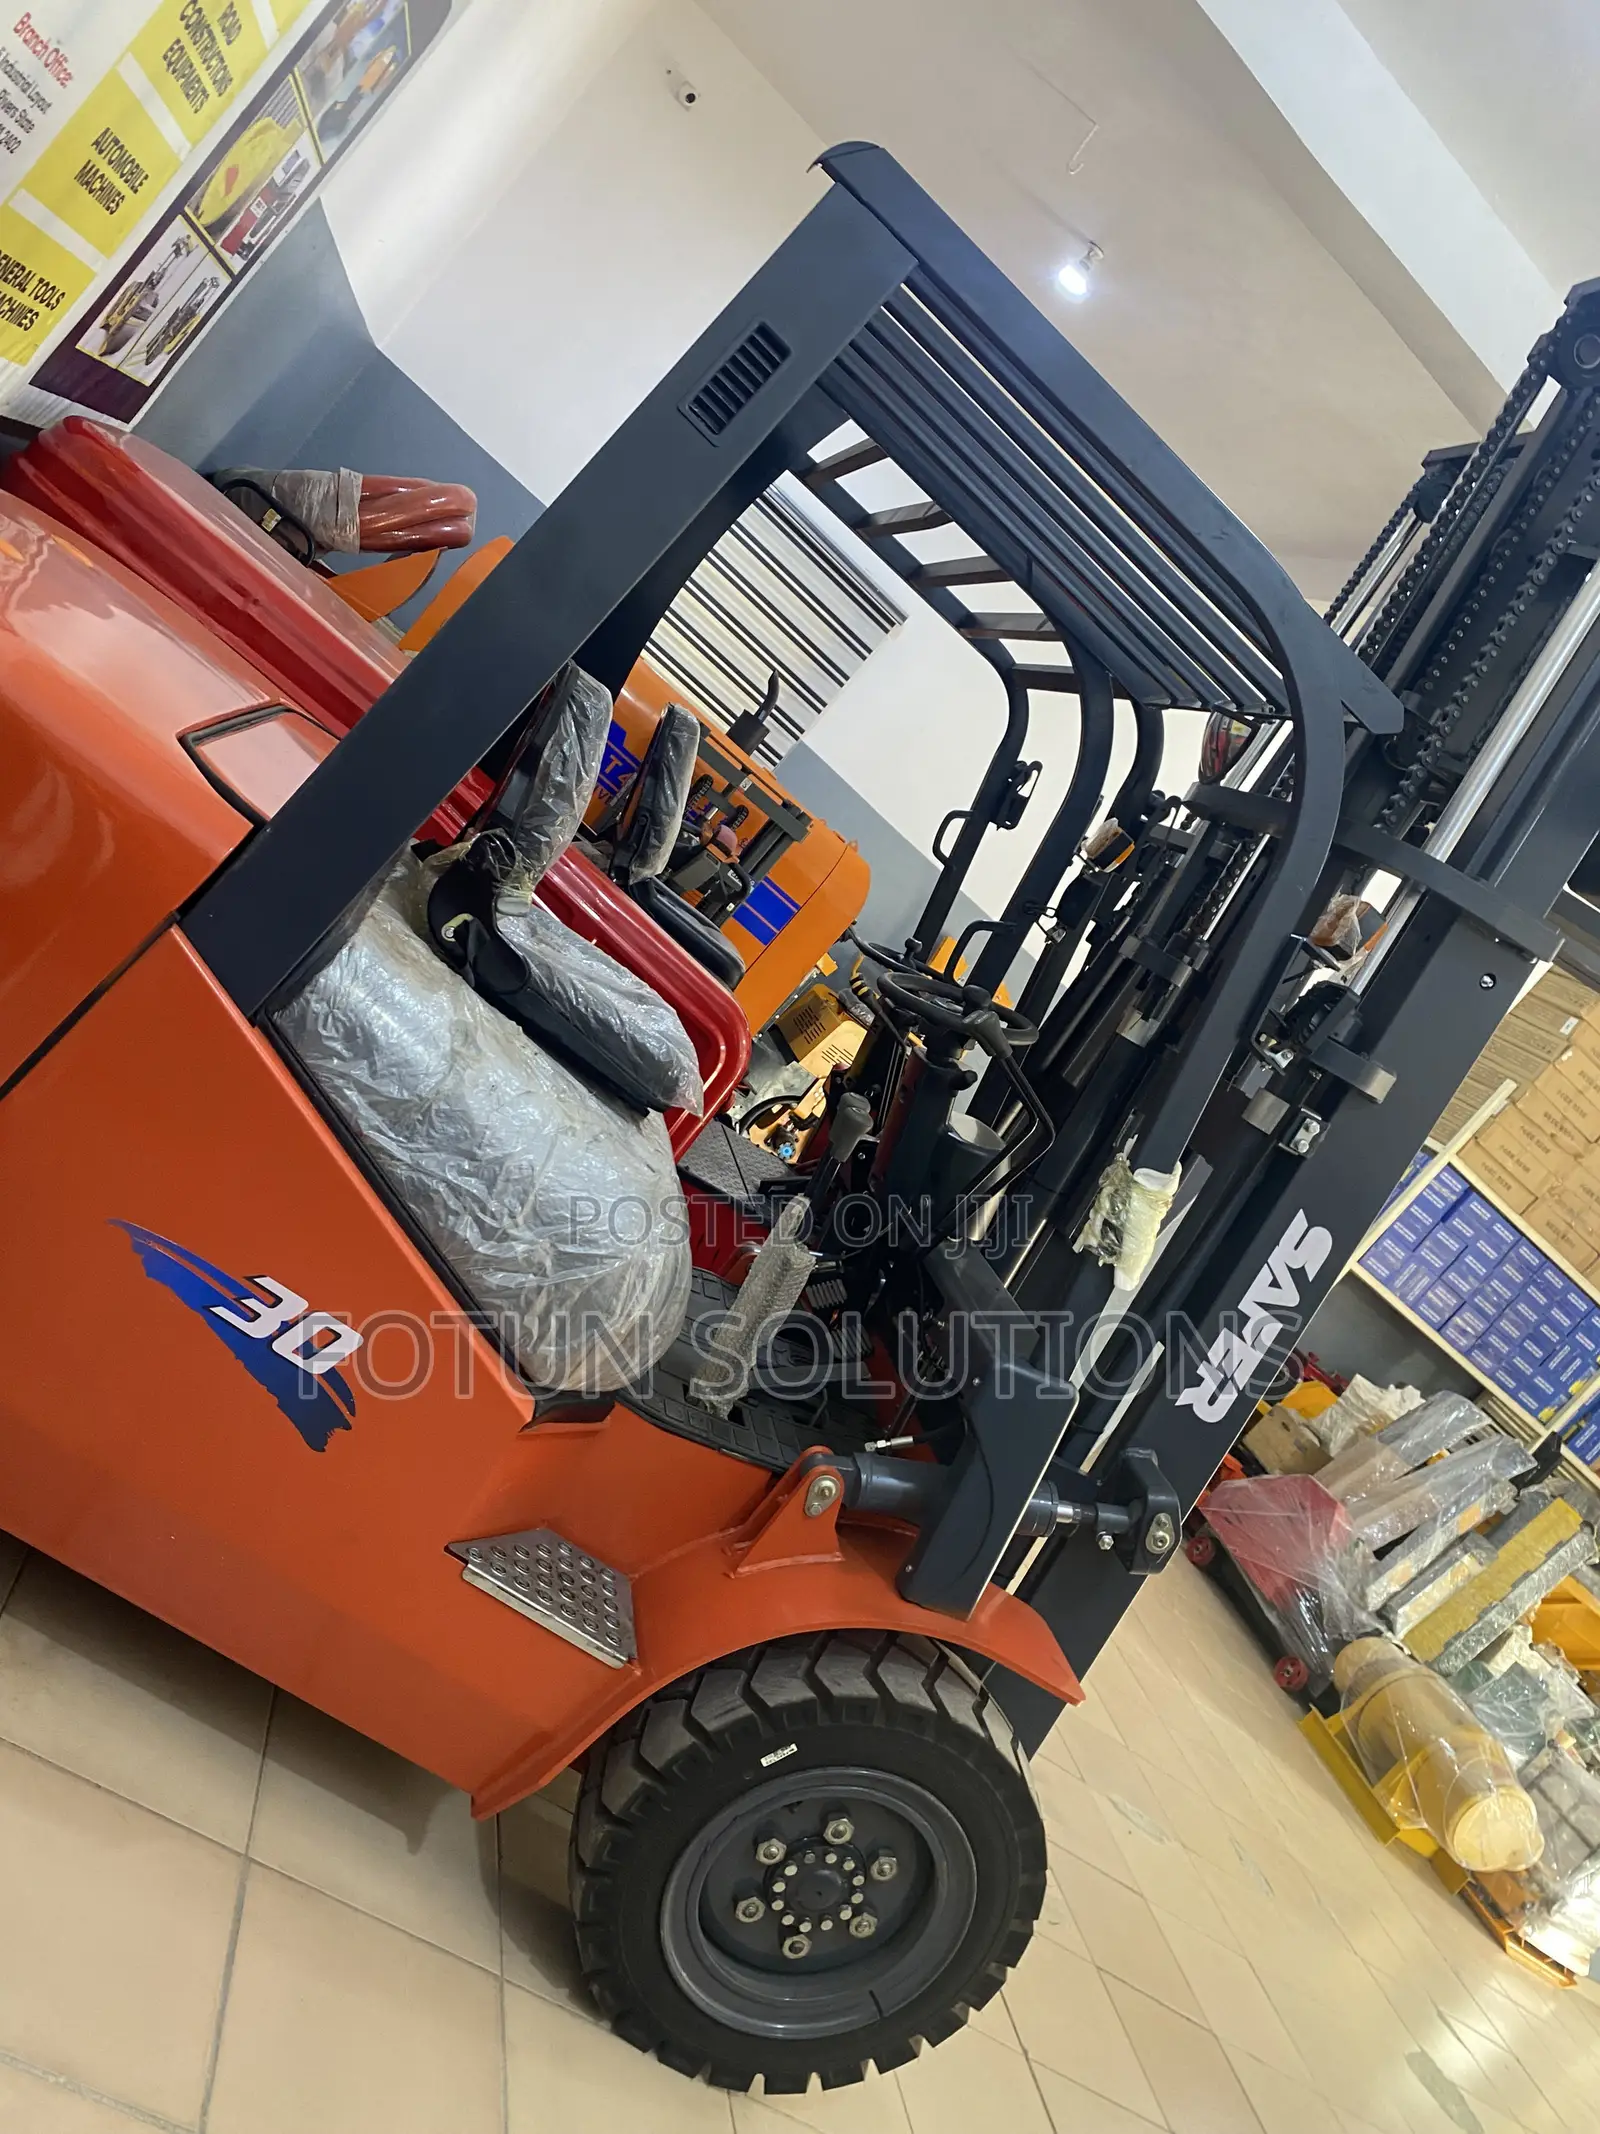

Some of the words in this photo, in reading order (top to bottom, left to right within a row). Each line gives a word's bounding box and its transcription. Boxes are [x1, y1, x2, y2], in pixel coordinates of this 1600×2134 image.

[14, 12, 51, 60] Branch
[217, 1, 242, 46] ROAD
[163, 38, 210, 114] EQUIPMENTS
[74, 159, 125, 215] MACHINES
[91, 127, 149, 194] AUTOMOBILE
[0, 250, 37, 293] ENERAL
[28, 277, 66, 311] TOOLS
[202, 1275, 364, 1375] 30
